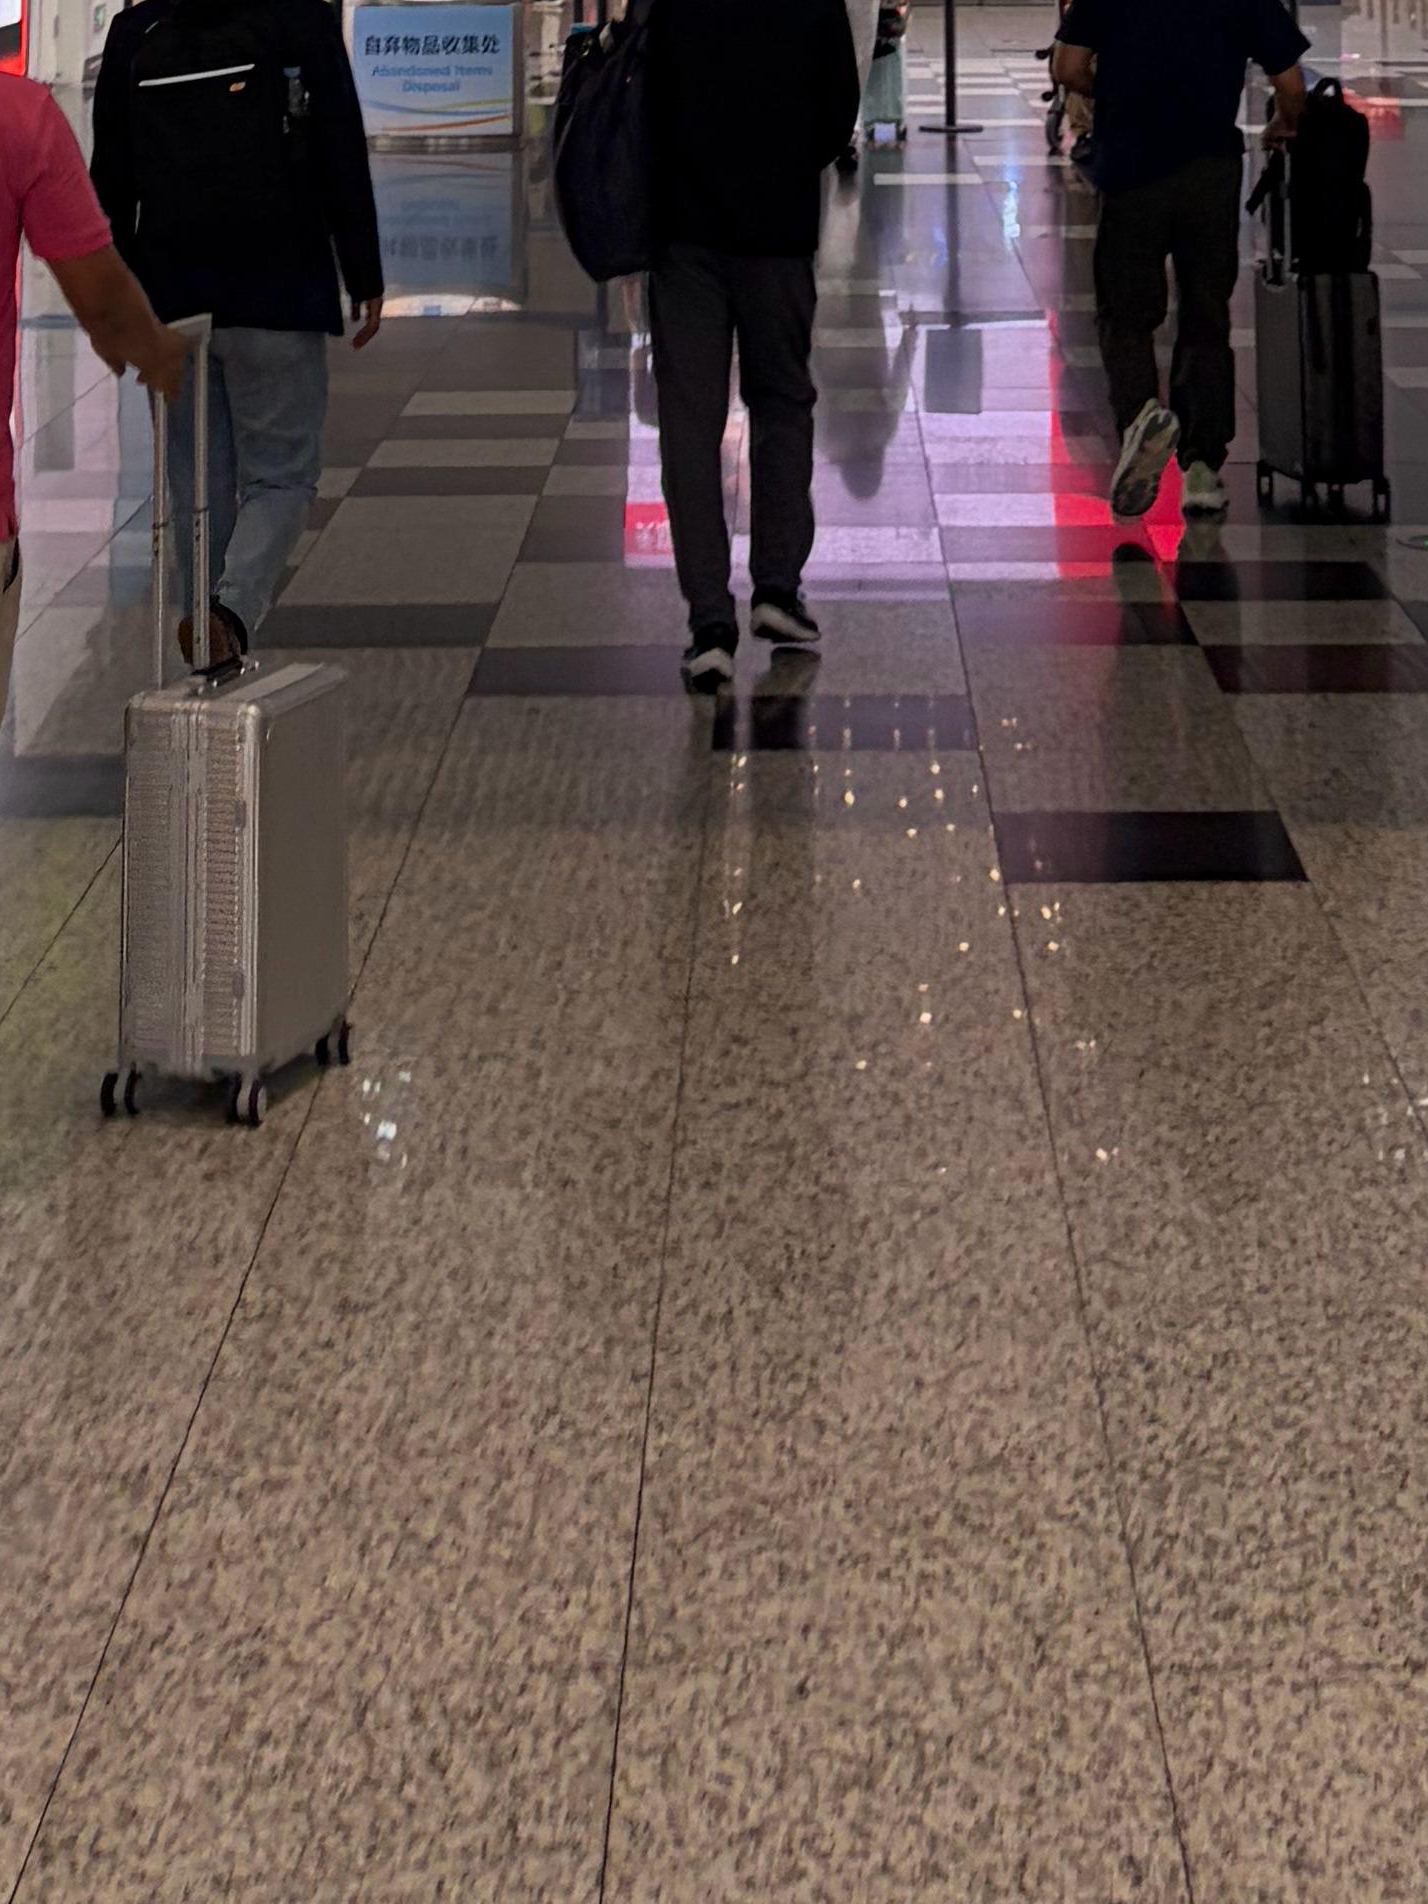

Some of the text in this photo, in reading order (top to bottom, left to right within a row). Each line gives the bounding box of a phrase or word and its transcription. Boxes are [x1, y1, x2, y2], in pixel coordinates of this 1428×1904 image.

[363, 34, 502, 56] 自弃物品收集处
[371, 64, 452, 77] Abandoned
[401, 79, 461, 94] Disposal
